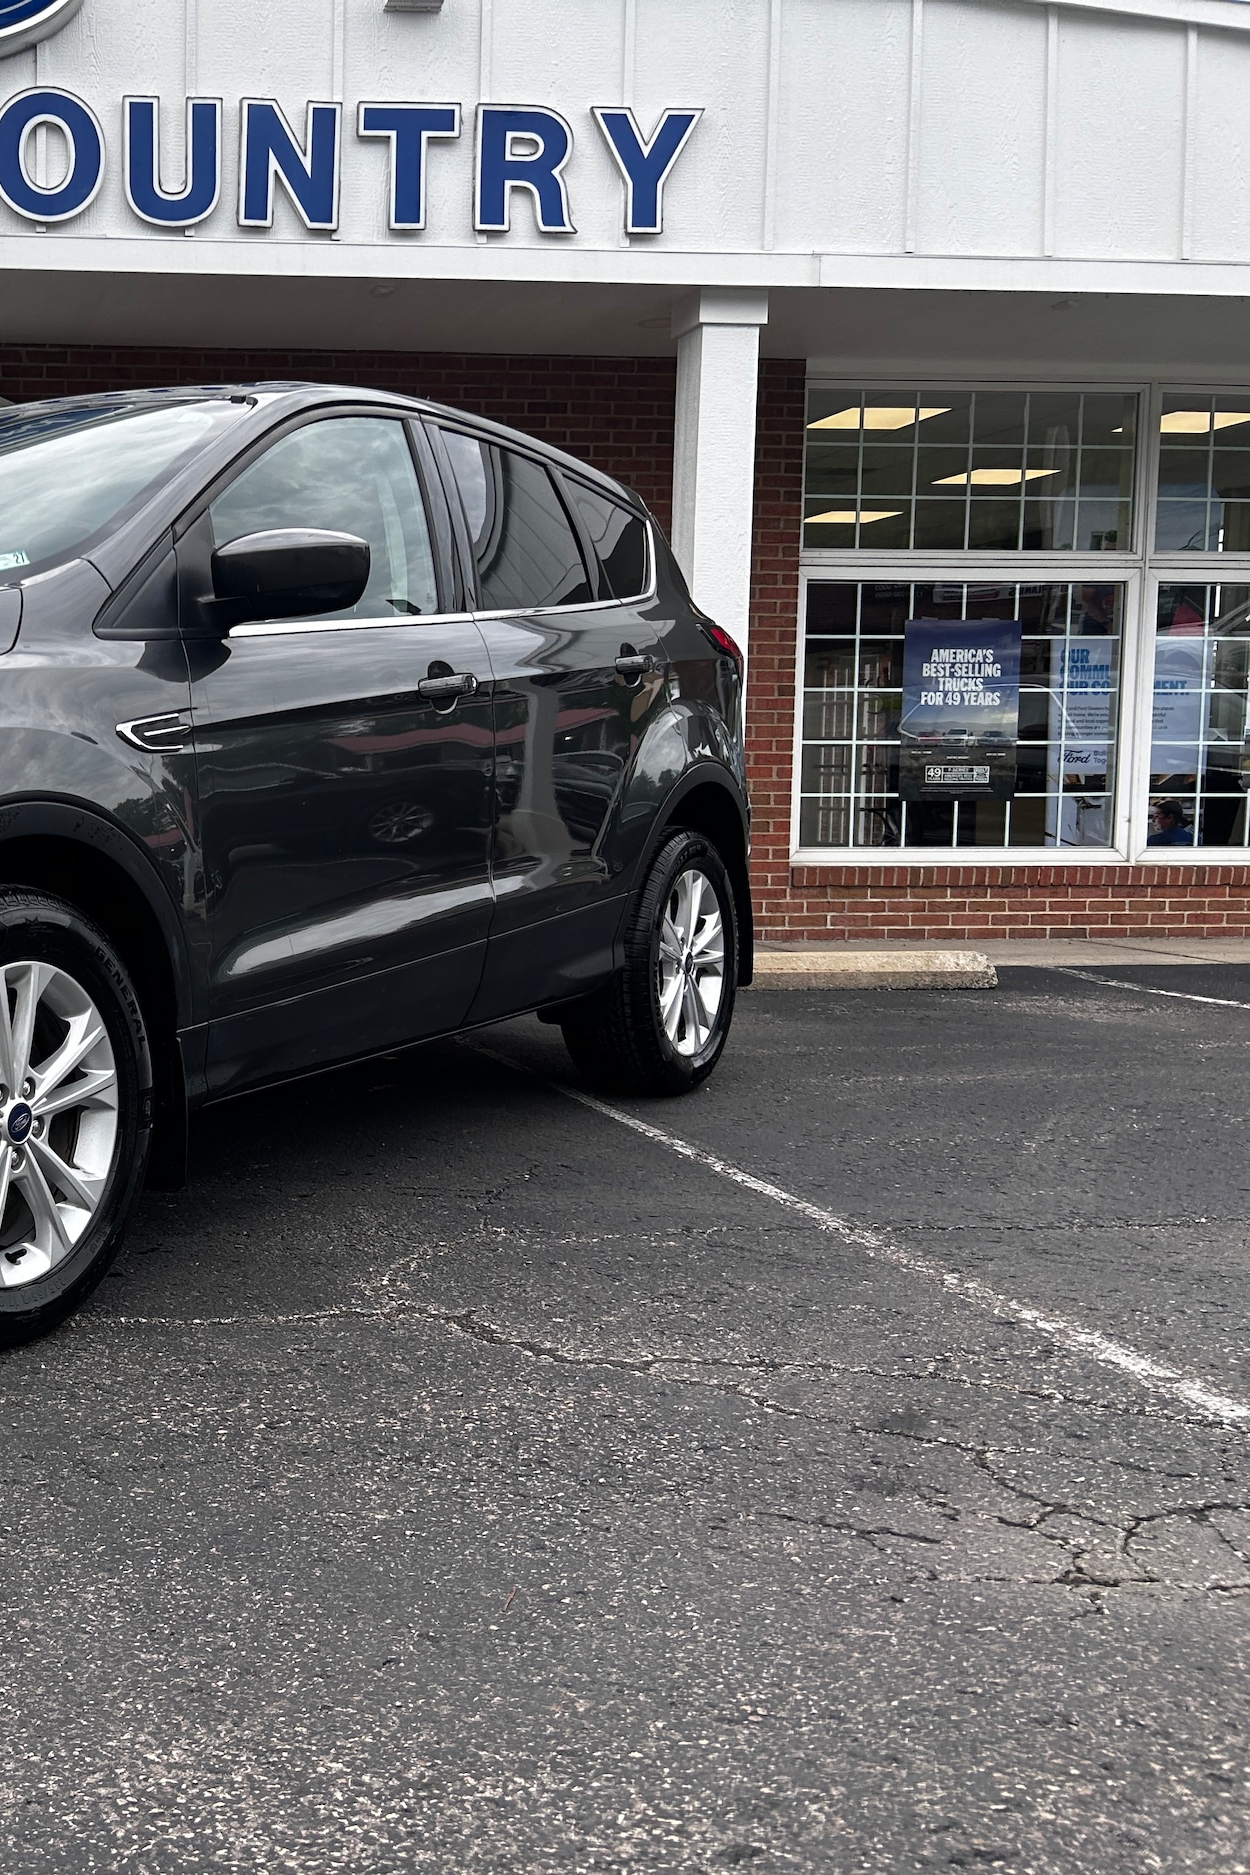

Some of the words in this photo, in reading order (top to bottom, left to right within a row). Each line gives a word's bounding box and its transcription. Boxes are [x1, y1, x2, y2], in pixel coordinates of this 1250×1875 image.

[931, 649, 994, 663] AMERICA'S
[1060, 649, 1090, 664] OUR
[922, 663, 1002, 677] BEST-SELLING
[938, 677, 984, 691] TRUCKS
[920, 692, 944, 705] FOR
[946, 692, 961, 705] 49
[963, 692, 1001, 705] YEARS
[1057, 749, 1091, 764] Ford
[927, 767, 942, 777] 49
[93, 945, 147, 1053] GENERAL
